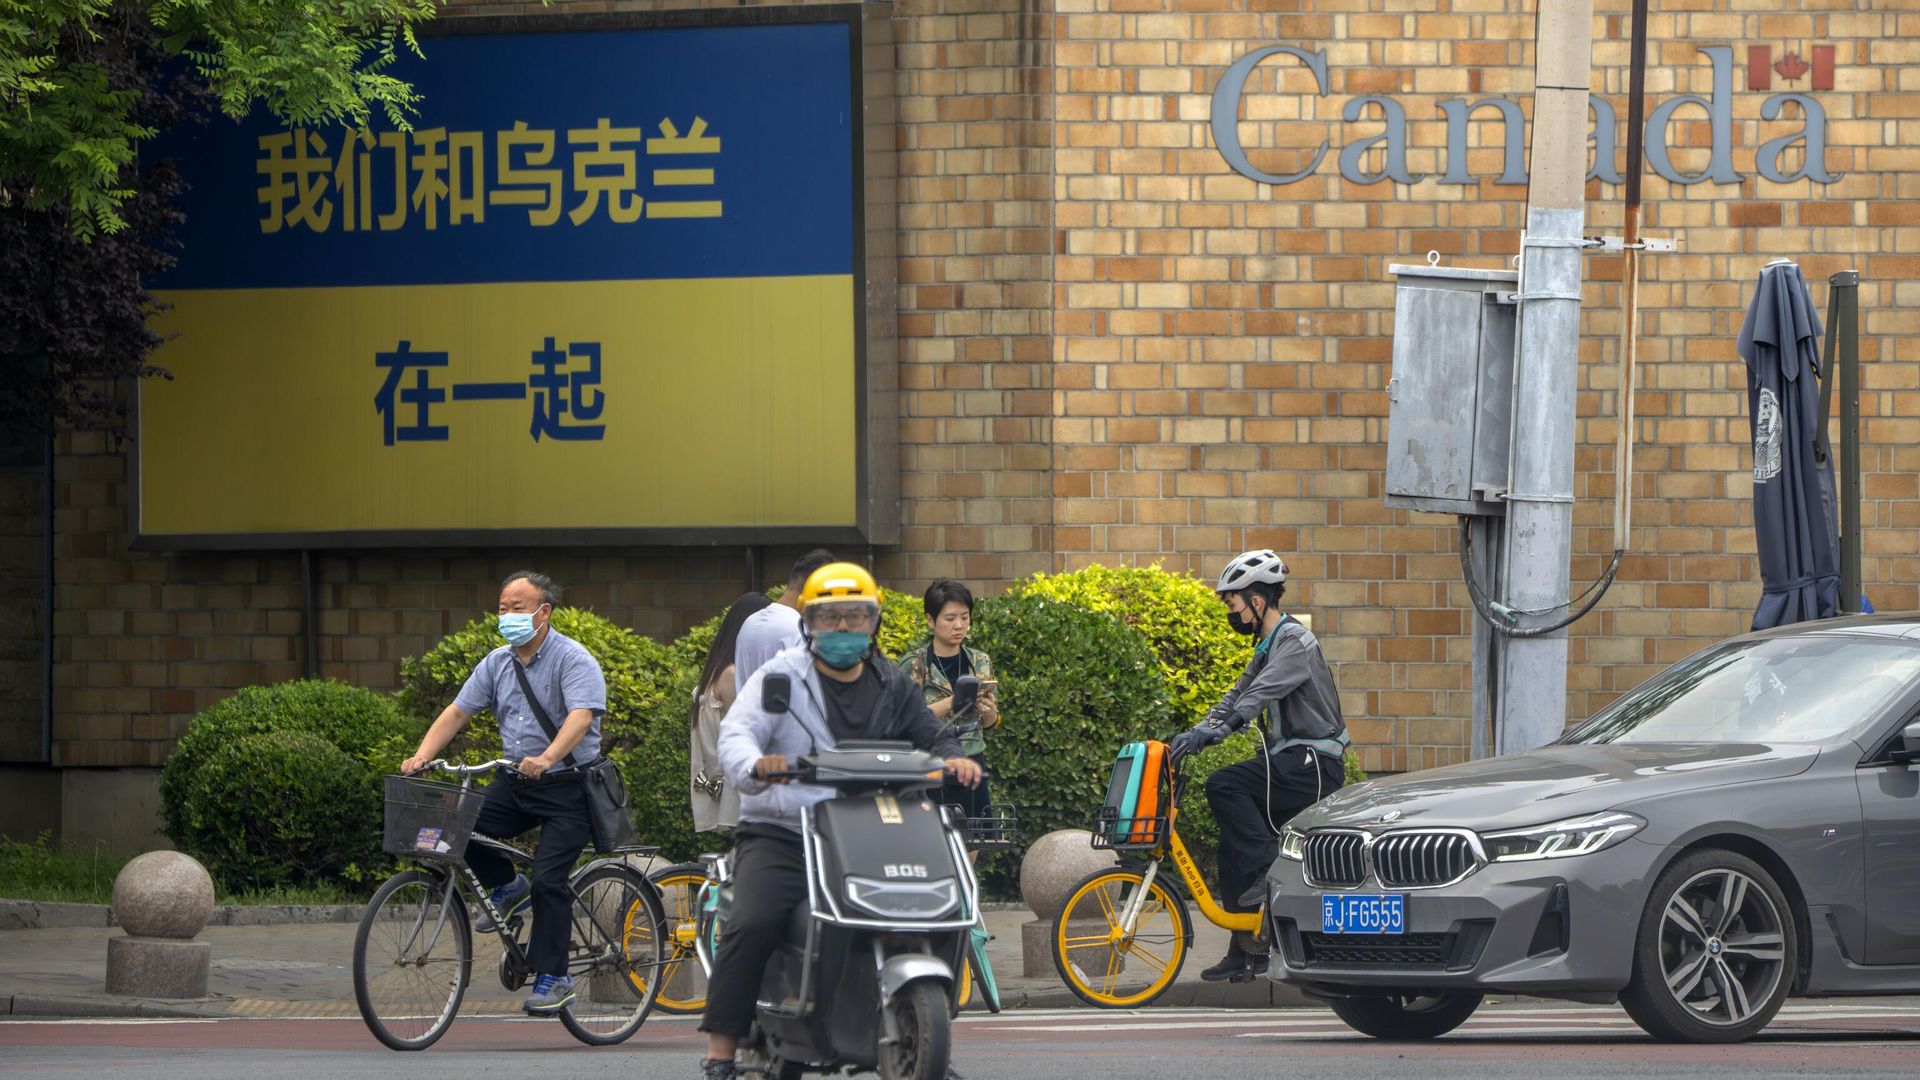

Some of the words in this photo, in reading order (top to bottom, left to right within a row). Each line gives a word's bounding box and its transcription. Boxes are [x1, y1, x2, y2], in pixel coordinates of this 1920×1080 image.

[1210, 45, 1844, 185] Canada
[256, 116, 722, 233] 我们和乌克兰
[374, 337, 606, 446] 在一起
[464, 868, 513, 936] PIGEON
